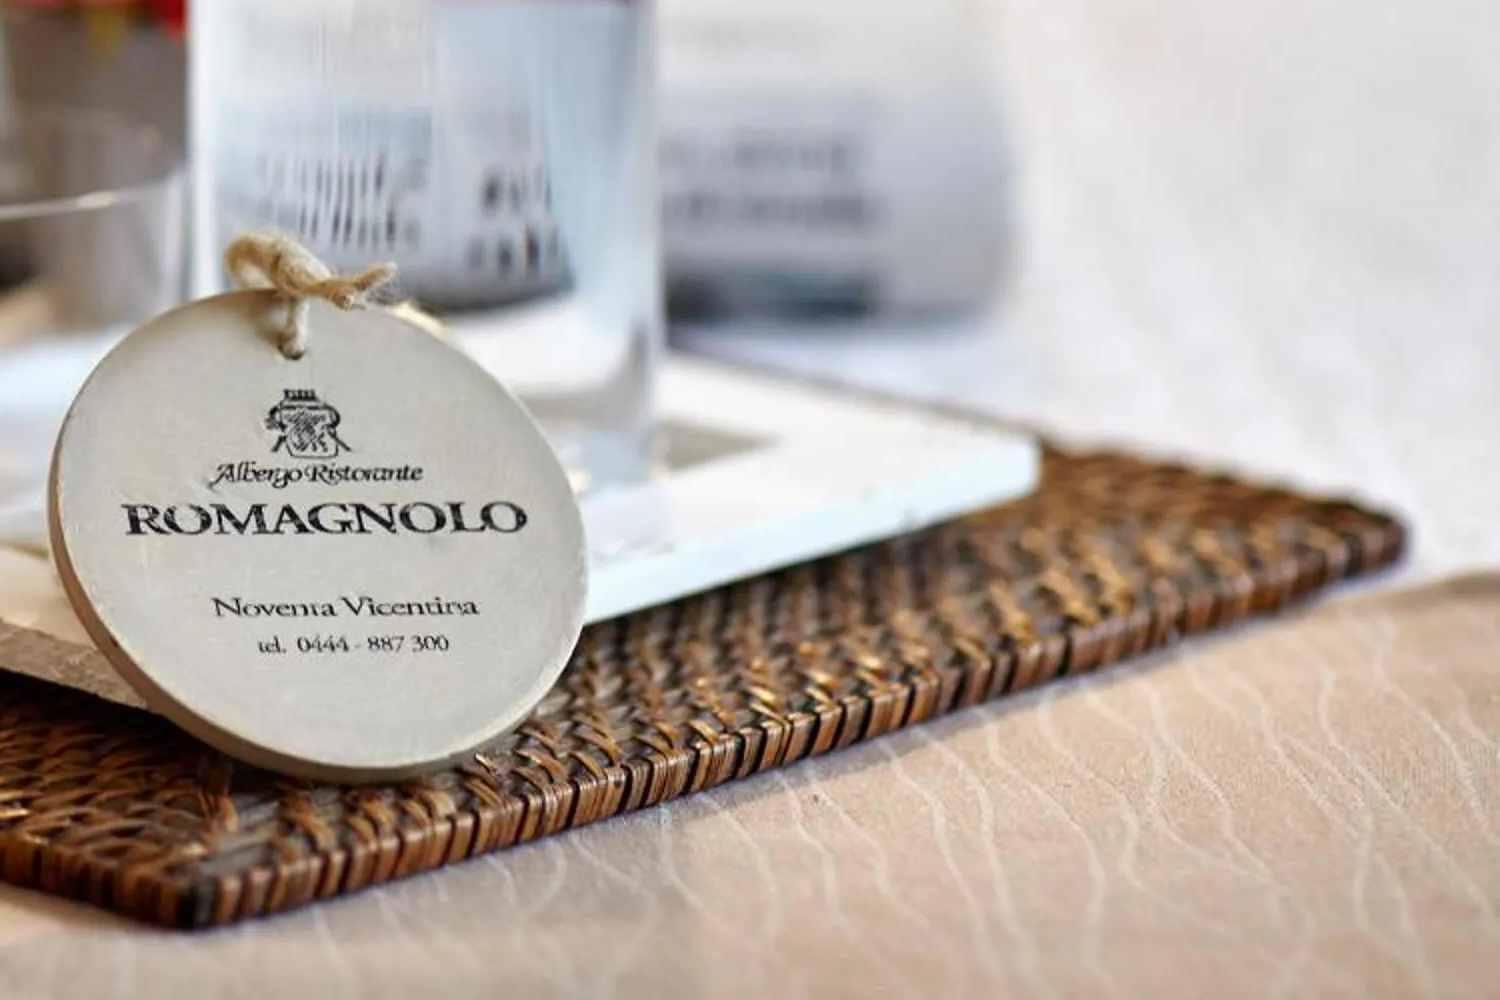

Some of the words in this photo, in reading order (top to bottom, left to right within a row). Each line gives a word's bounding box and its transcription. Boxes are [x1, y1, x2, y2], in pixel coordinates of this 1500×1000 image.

[208, 461, 303, 489] Albergo
[304, 463, 424, 486] Ristorante
[121, 500, 528, 536] ROMAGNOLO
[340, 596, 480, 617] Vicentina
[297, 635, 350, 653] 0444
[367, 635, 404, 653] 887
[411, 635, 449, 652] 300
